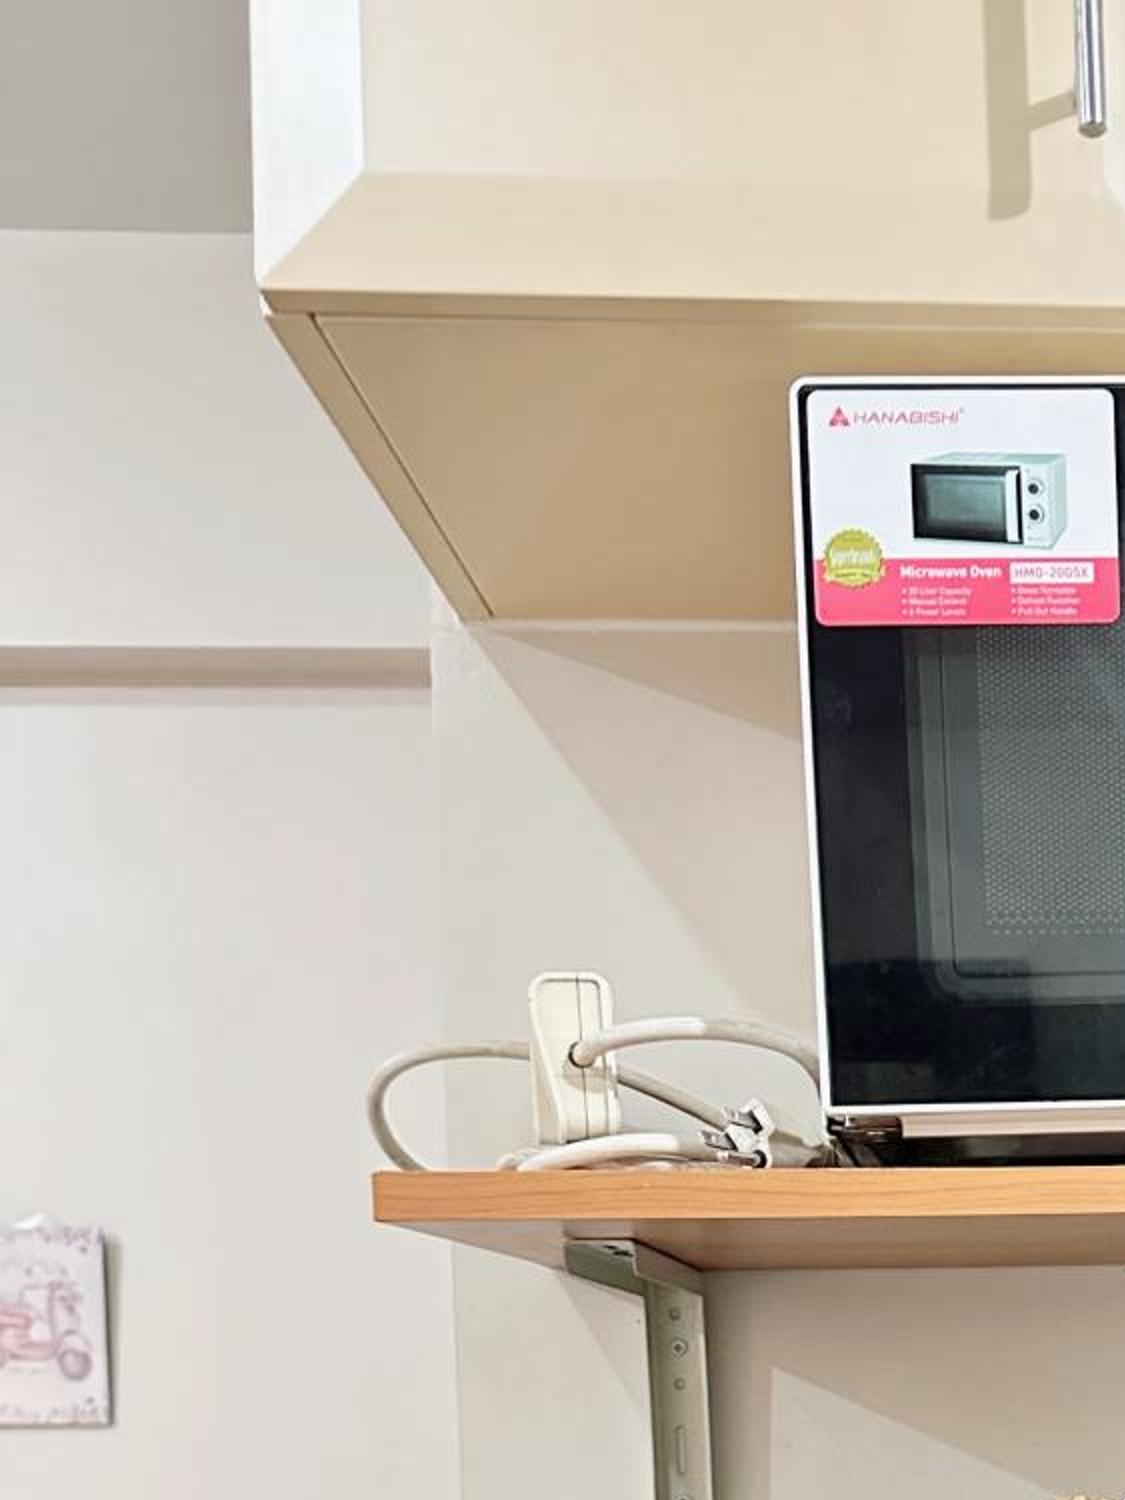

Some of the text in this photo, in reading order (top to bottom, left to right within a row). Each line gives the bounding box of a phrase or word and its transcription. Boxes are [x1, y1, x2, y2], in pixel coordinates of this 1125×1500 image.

[853, 410, 959, 424] HANABISHI
[901, 566, 1002, 578] Microwave Oven
